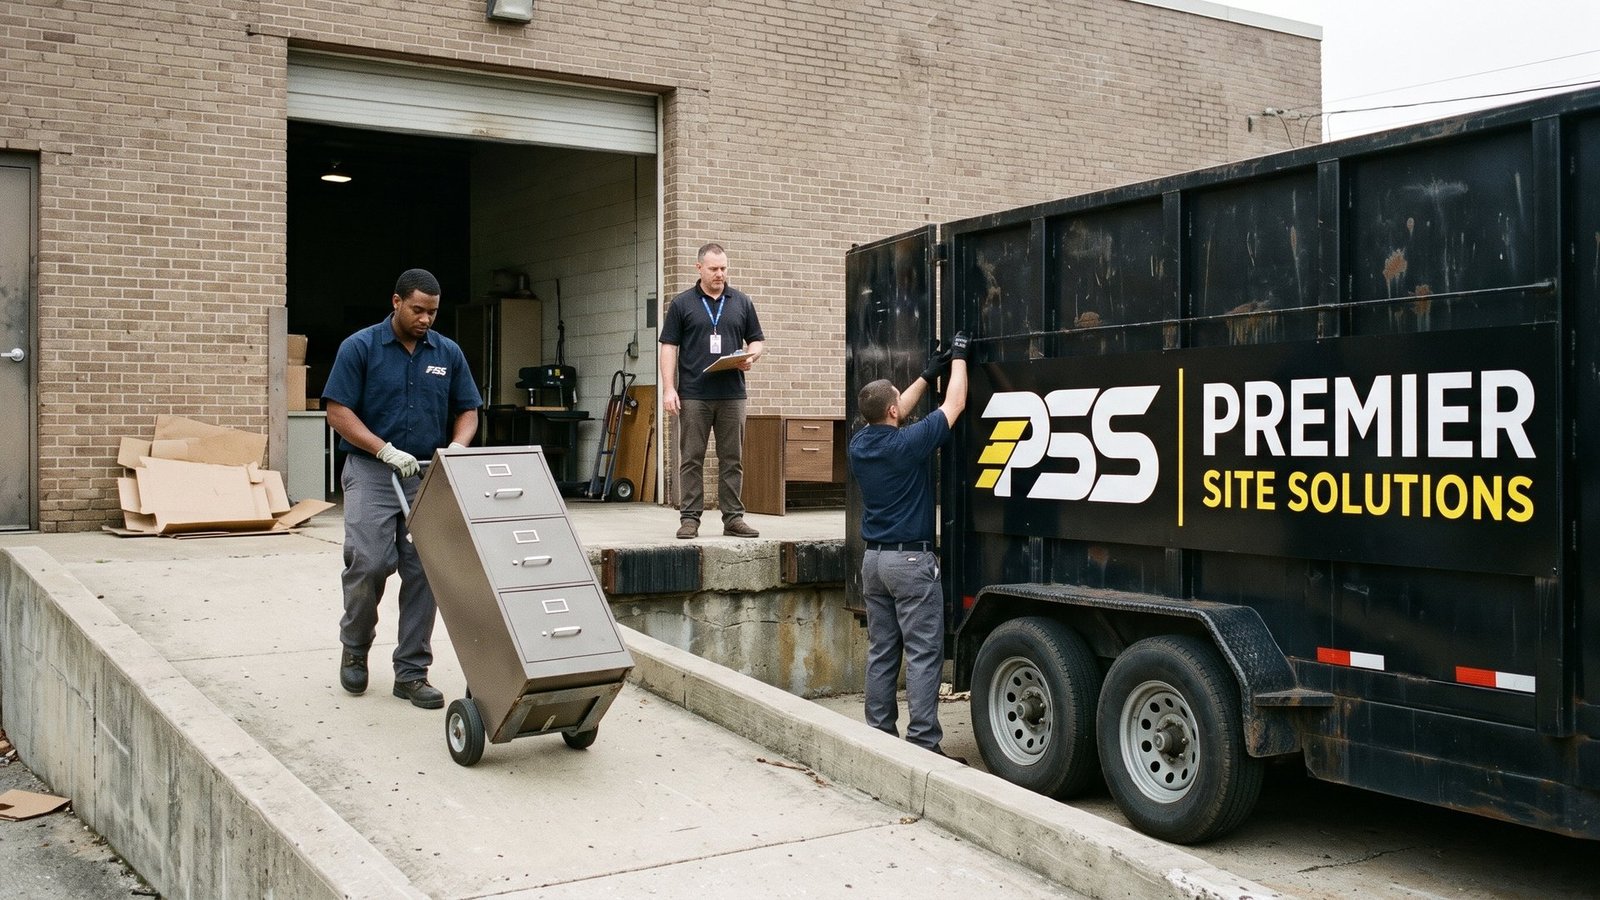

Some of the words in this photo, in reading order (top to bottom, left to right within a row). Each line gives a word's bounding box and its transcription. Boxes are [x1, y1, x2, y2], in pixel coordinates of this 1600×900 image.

[975, 385, 1161, 504] PSS
[1203, 369, 1537, 459] PREMIER
[1202, 469, 1276, 510] SITE
[1287, 471, 1535, 523] SOLUTIONS
